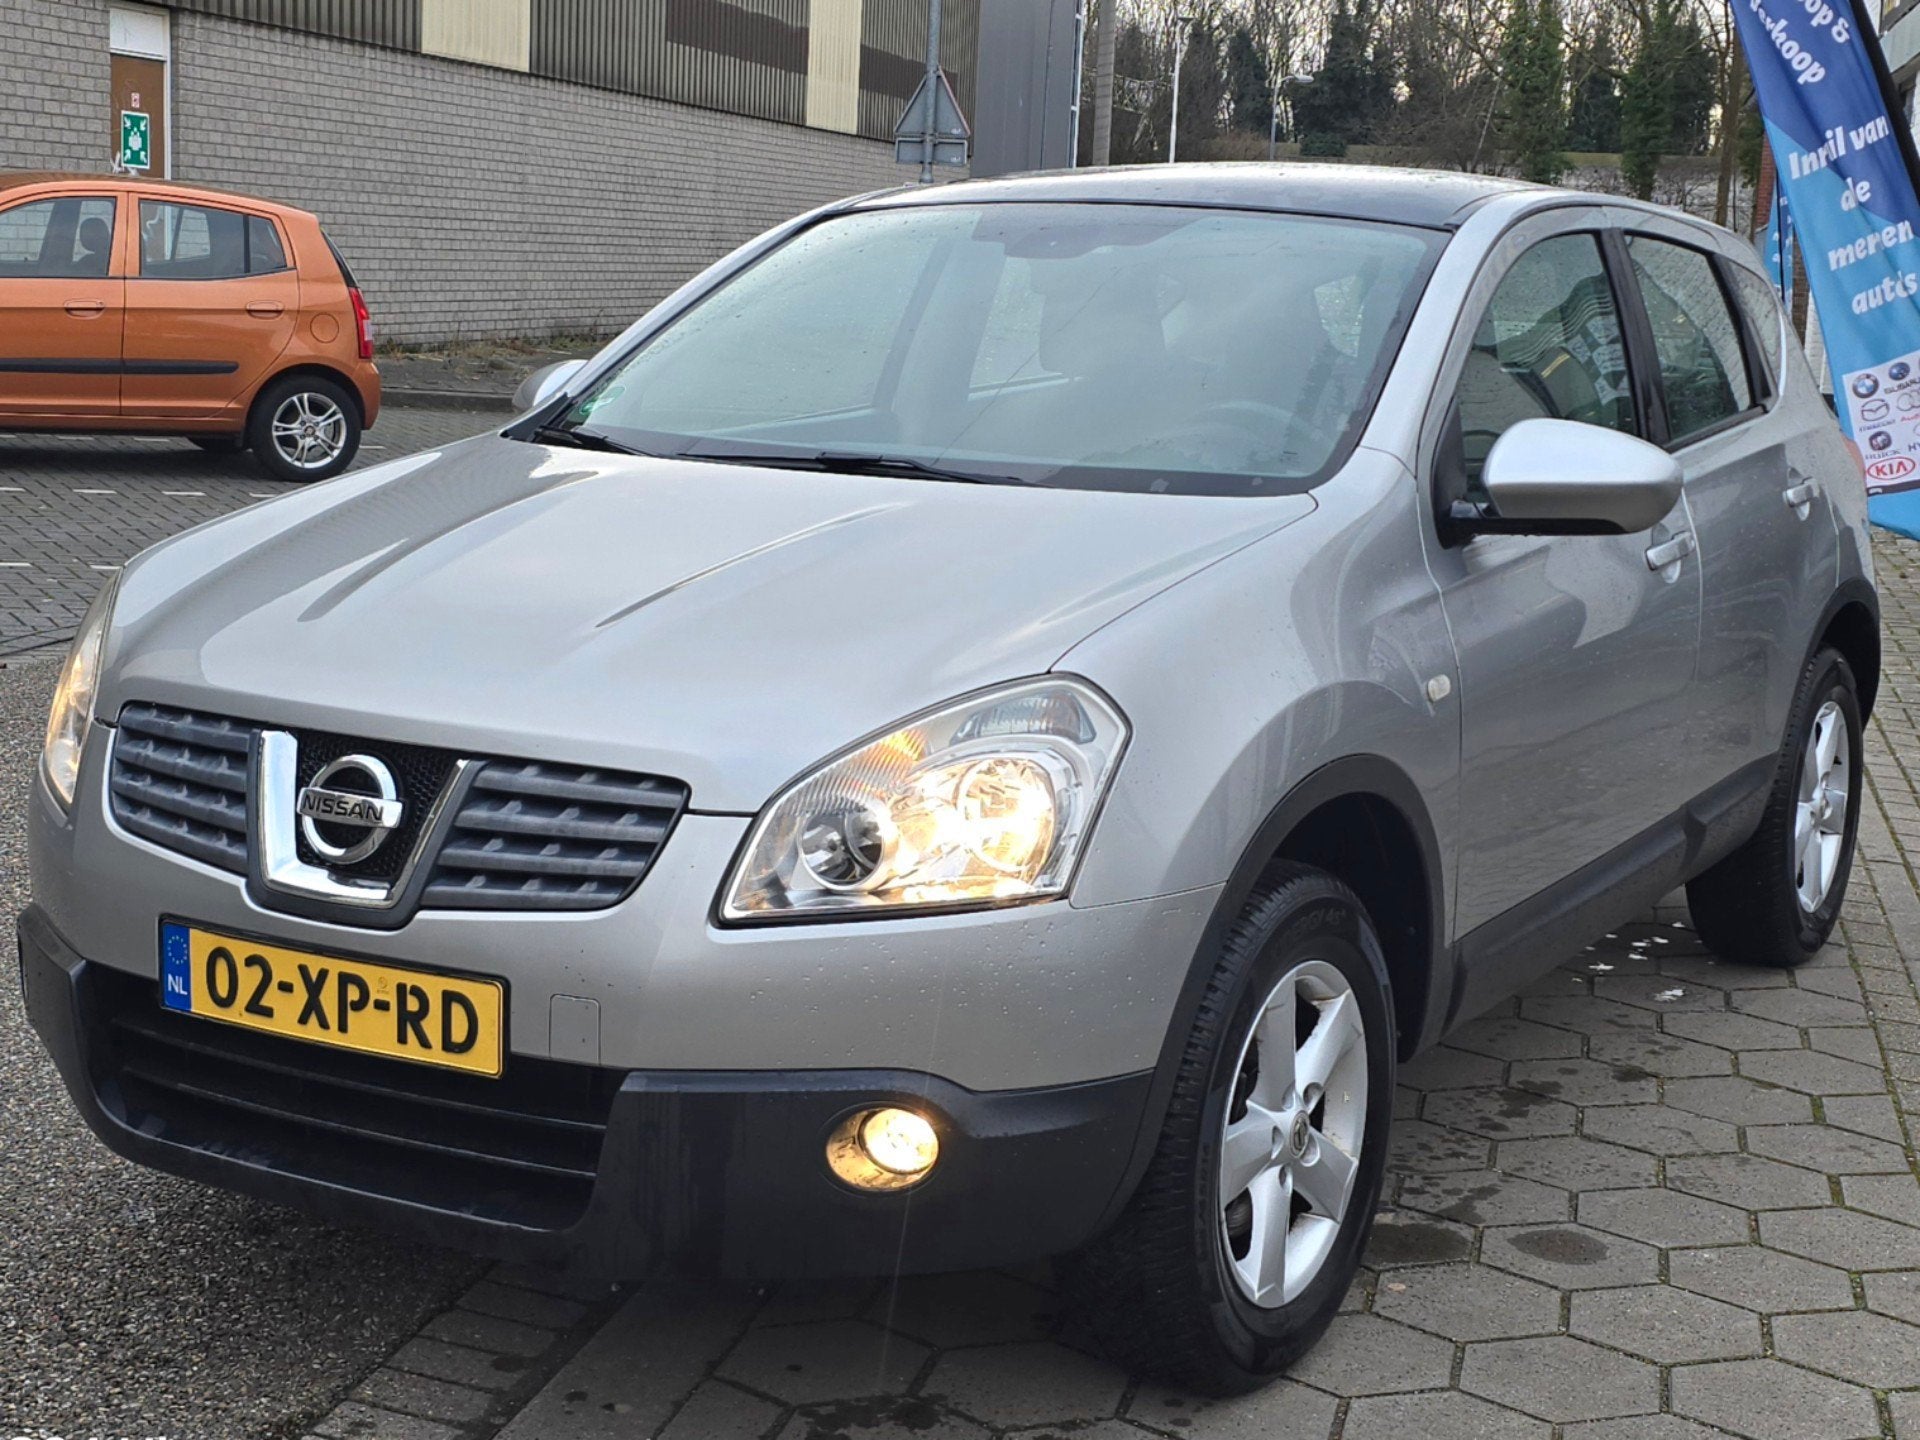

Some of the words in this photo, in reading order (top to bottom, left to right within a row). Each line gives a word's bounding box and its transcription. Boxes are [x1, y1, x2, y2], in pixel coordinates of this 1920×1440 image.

[1849, 115, 1889, 151] van
[1875, 461, 1907, 476] KIA
[302, 795, 384, 821] NISSAN
[167, 974, 188, 996] NL
[206, 946, 479, 1054] 02-XP-RD
